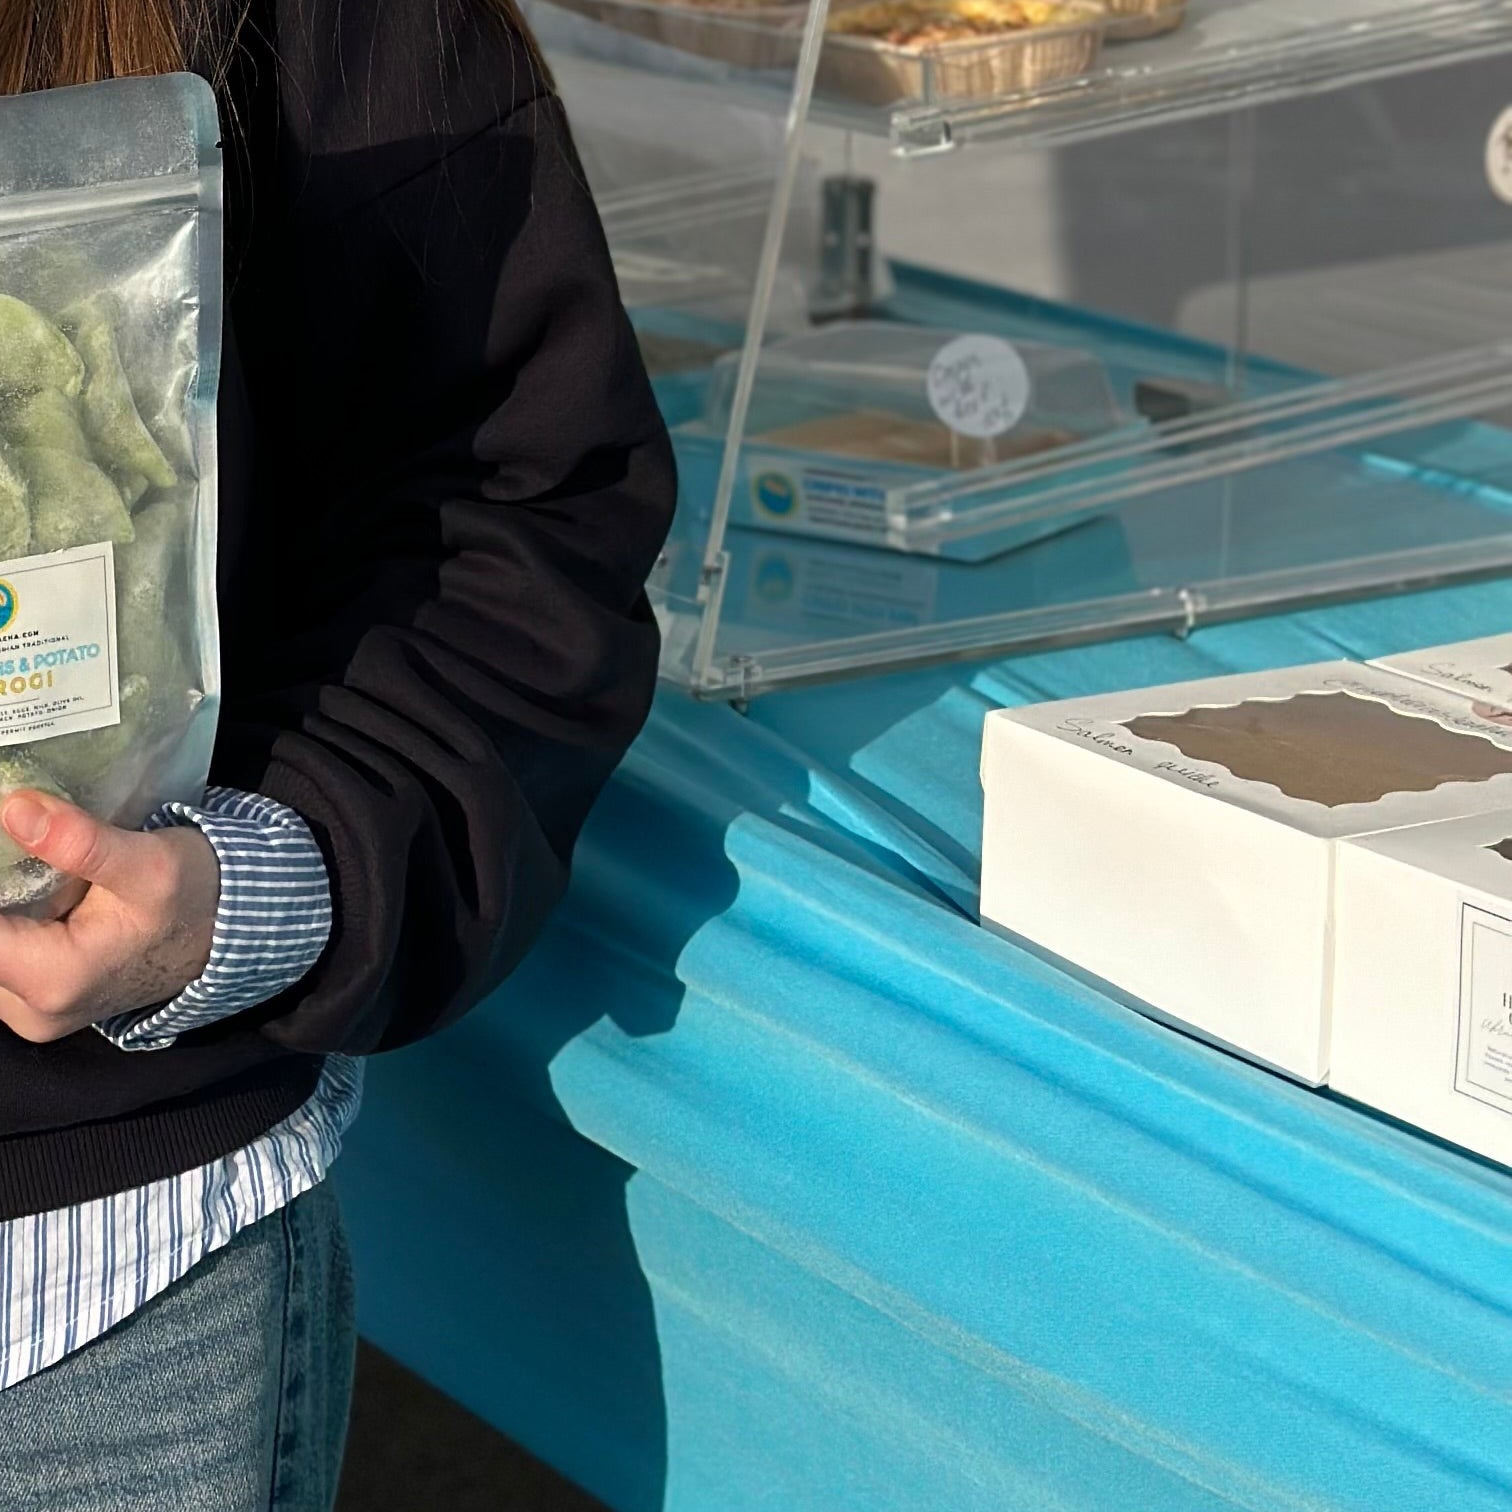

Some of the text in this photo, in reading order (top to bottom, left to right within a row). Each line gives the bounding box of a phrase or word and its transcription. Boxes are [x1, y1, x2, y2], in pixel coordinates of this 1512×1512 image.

[19, 657, 30, 673] &
[33, 643, 101, 670] POTATO
[1056, 718, 1133, 755] Salmon
